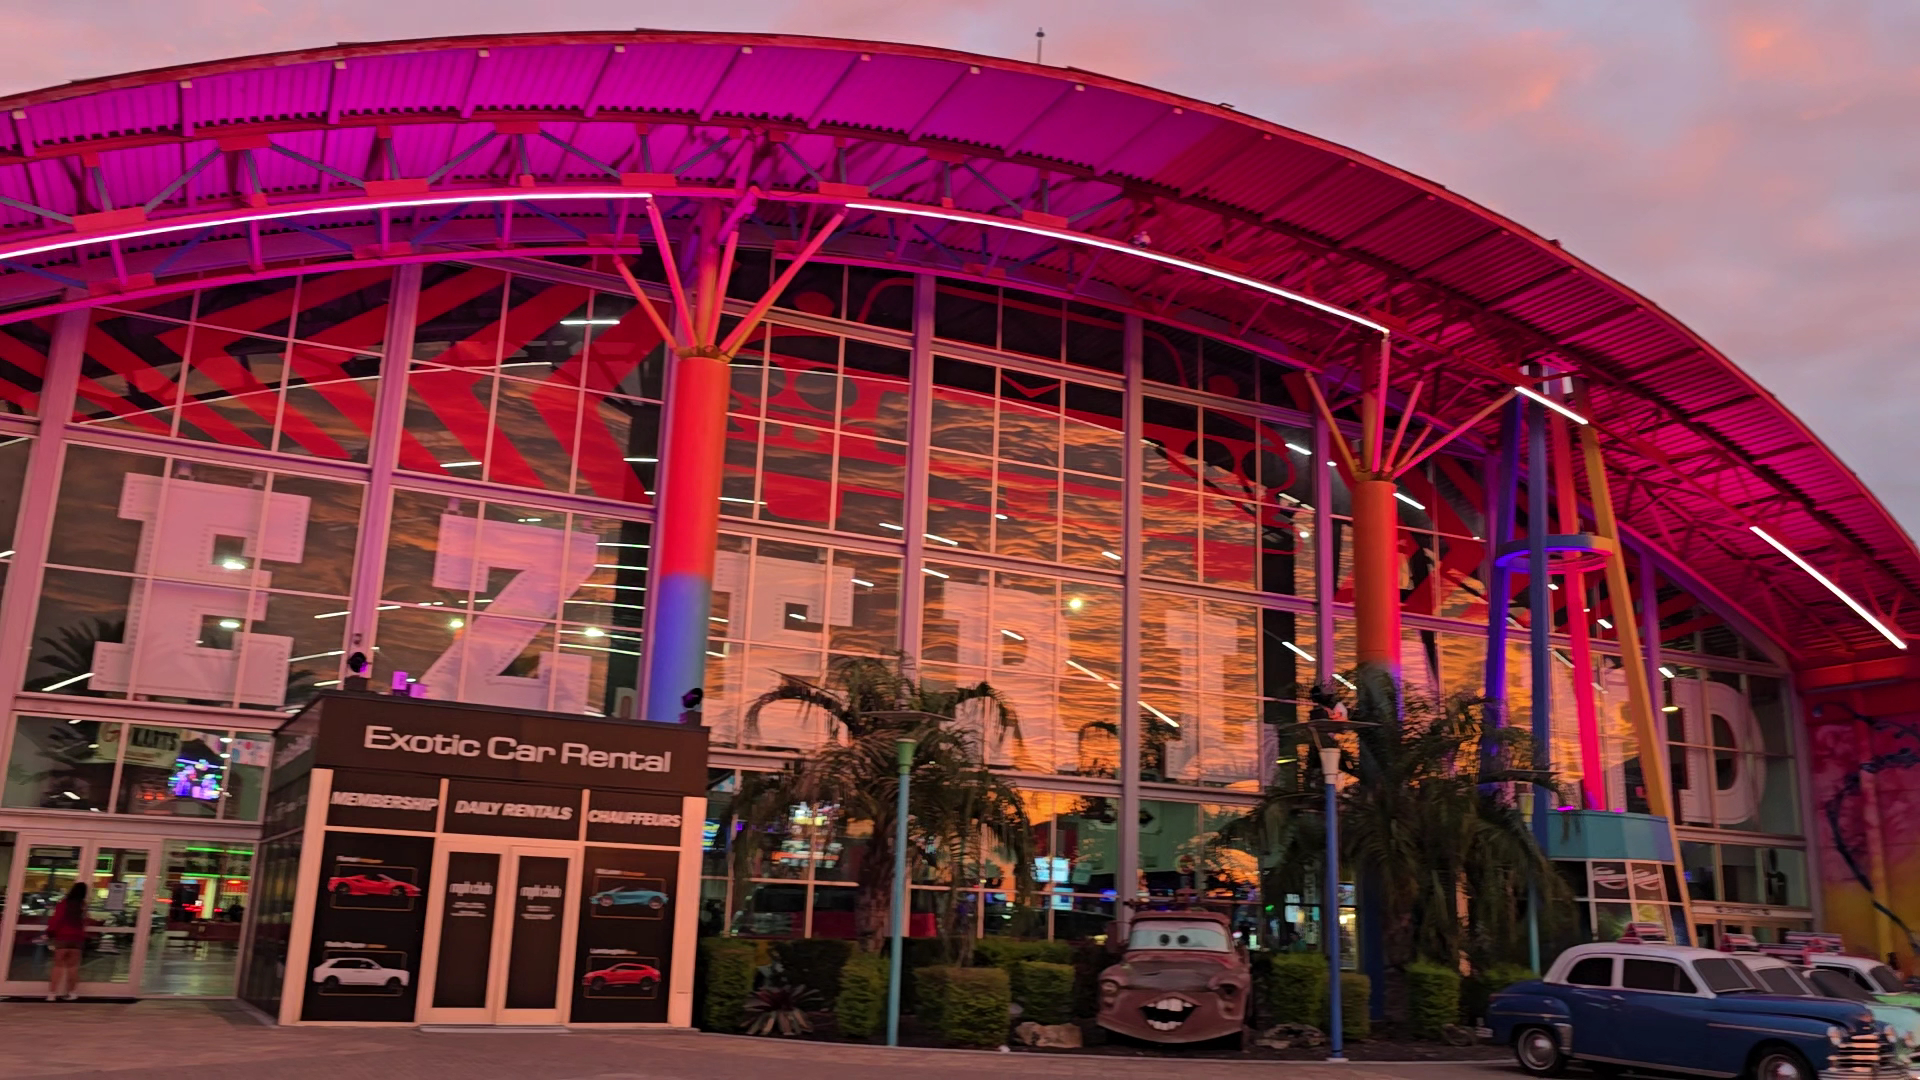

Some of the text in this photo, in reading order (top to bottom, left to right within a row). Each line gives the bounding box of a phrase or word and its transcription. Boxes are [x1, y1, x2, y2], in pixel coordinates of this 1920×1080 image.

[363, 725, 672, 773] Exotic Car Rental
[331, 791, 439, 811] MEMBERSHIP
[455, 800, 573, 820] DAILY RENTALS
[588, 809, 682, 828] CHAUFFEURS
